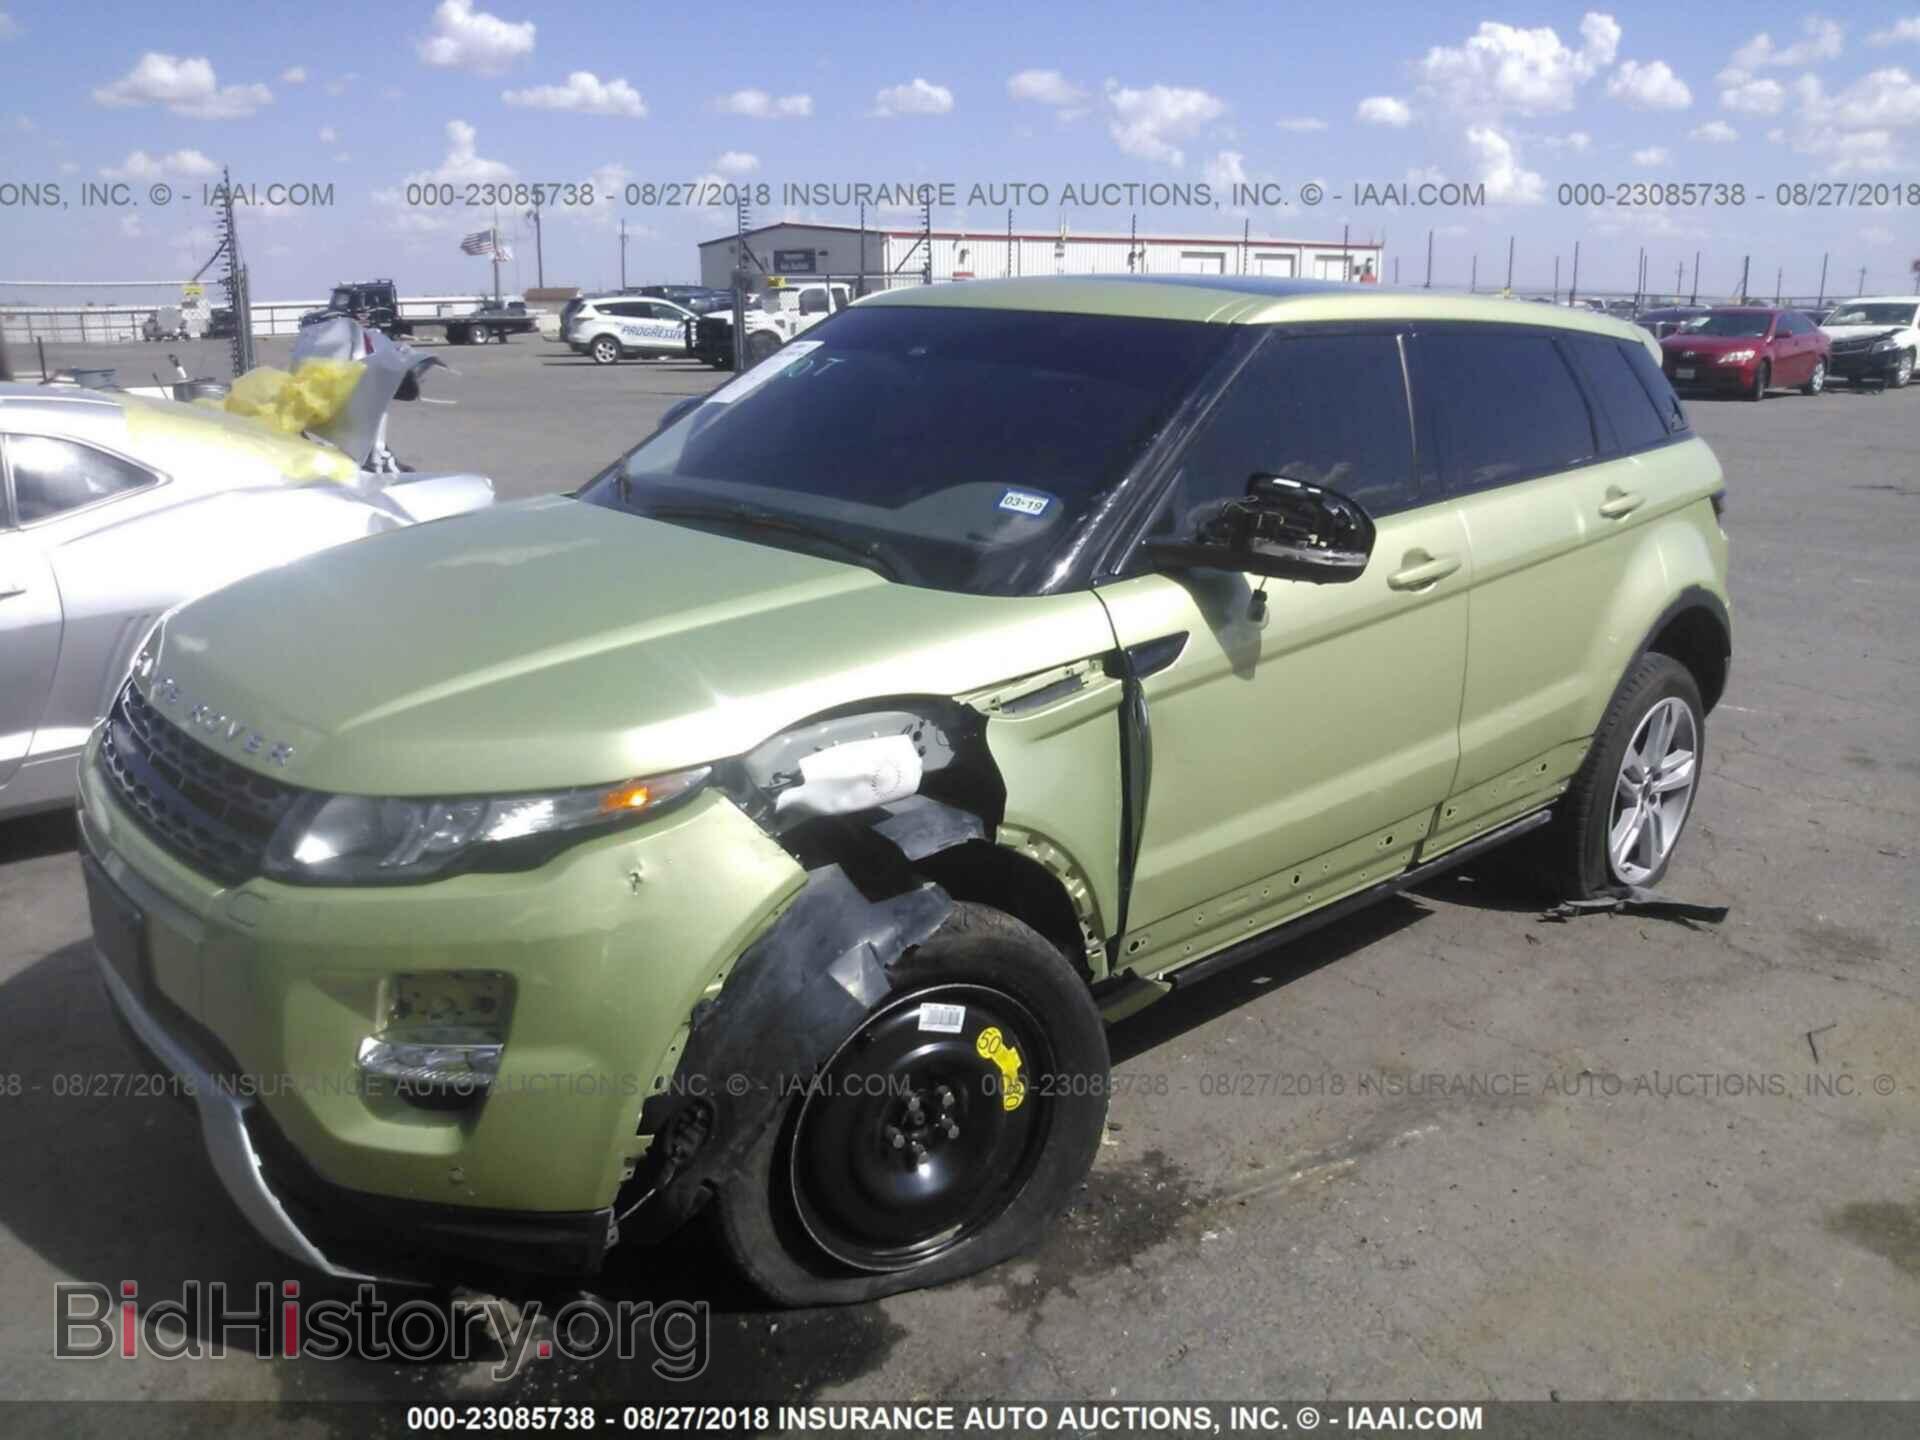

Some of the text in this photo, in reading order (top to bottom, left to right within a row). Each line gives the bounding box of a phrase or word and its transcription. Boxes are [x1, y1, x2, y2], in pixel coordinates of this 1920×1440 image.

[622, 325, 686, 341] PROGRESSIV
[1004, 496, 1043, 511] 03-19
[978, 1031, 1001, 1053] 50
